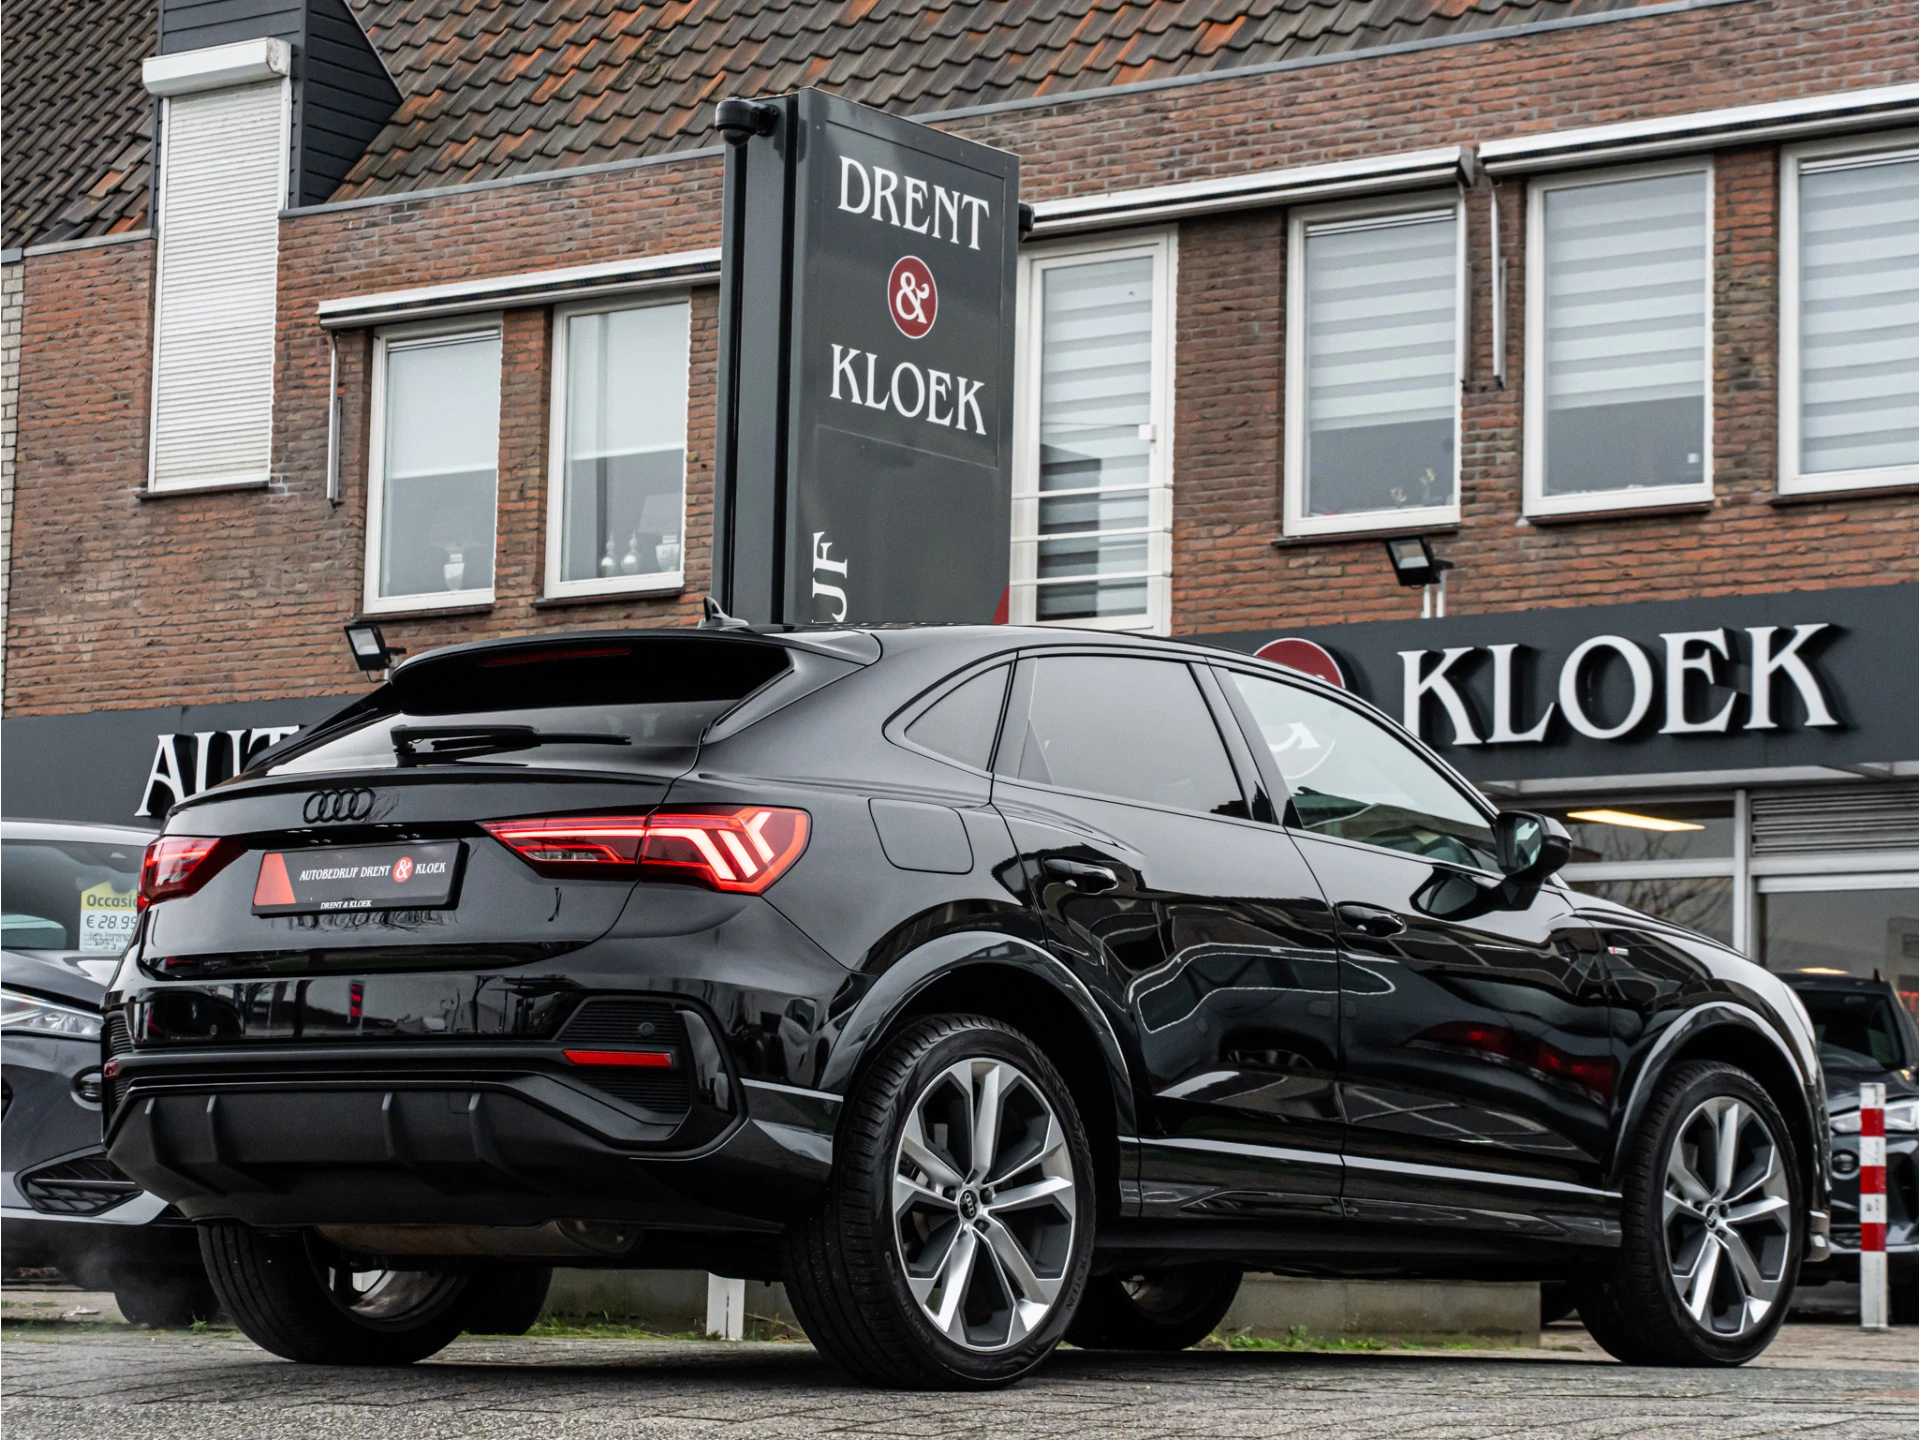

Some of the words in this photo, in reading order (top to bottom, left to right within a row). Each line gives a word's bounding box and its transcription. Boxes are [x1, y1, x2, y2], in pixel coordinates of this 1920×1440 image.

[838, 155, 990, 251] DRENT
[895, 271, 929, 325] &
[829, 343, 987, 436] KLOEK
[811, 531, 848, 623] JF
[1397, 623, 1838, 746] KLOEK
[299, 867, 359, 881] AUTOBEDRIJF
[360, 865, 391, 878] DRENT
[395, 859, 412, 879] &
[415, 862, 446, 874] KLOEK
[320, 901, 343, 910] DRENT
[349, 900, 372, 908] KLOEK
[86, 914, 95, 929] €
